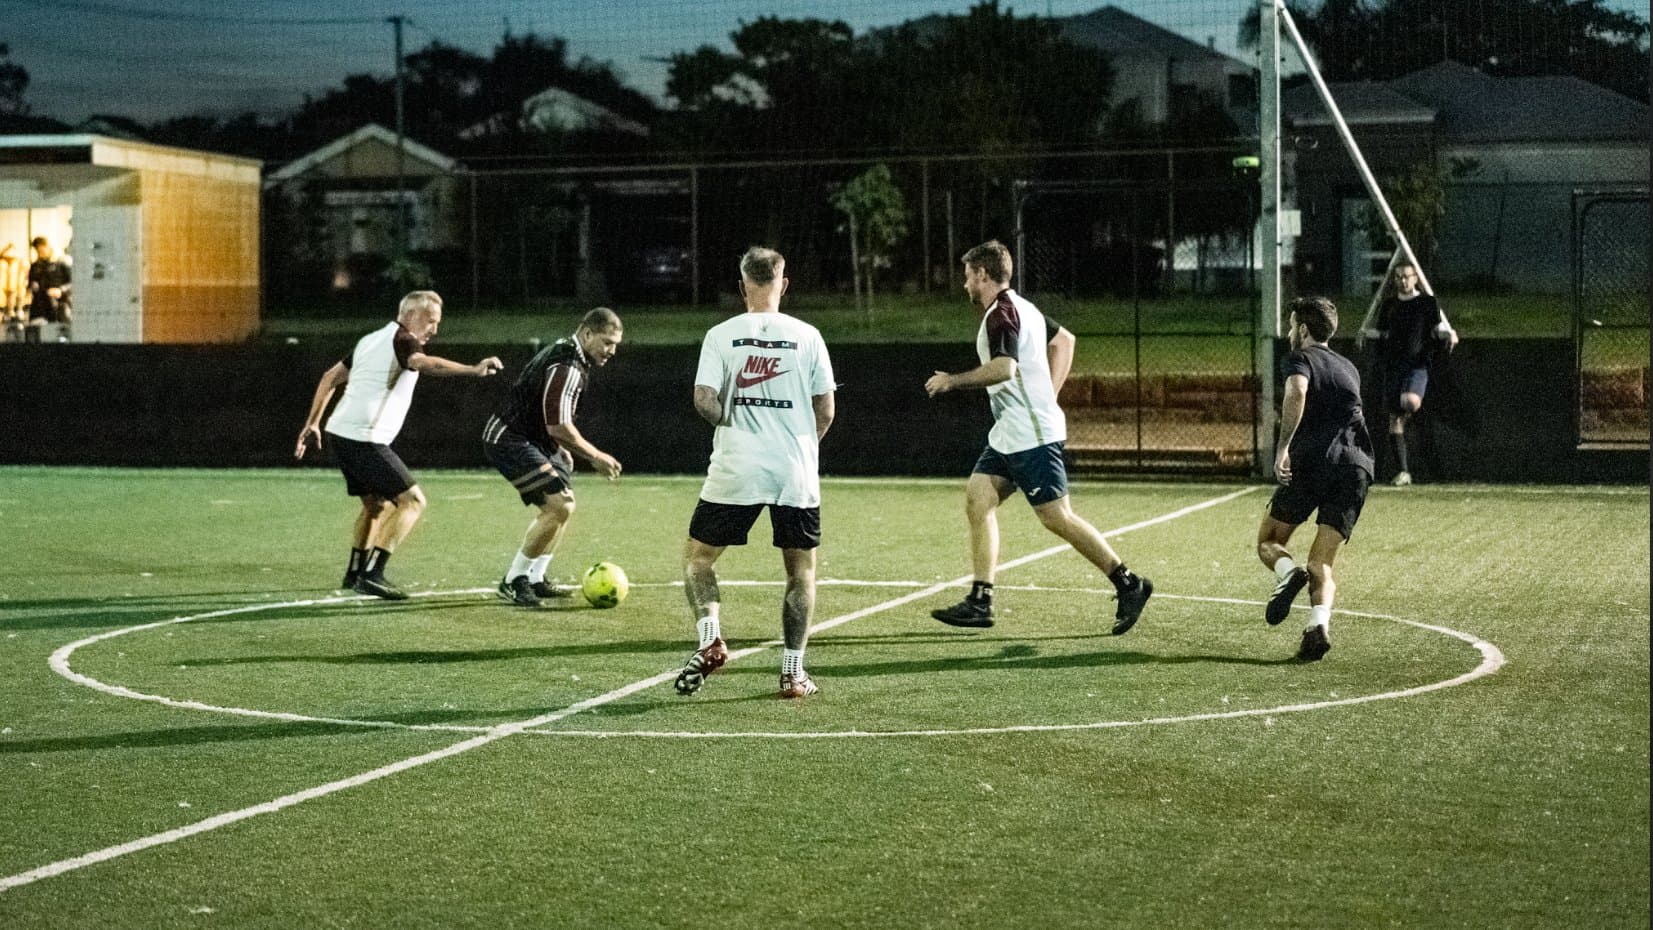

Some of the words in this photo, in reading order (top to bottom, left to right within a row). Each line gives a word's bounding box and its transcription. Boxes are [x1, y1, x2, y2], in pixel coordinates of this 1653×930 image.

[739, 339, 790, 348] TEAM
[743, 355, 782, 375] NIKE
[736, 398, 789, 407] SPORTS
